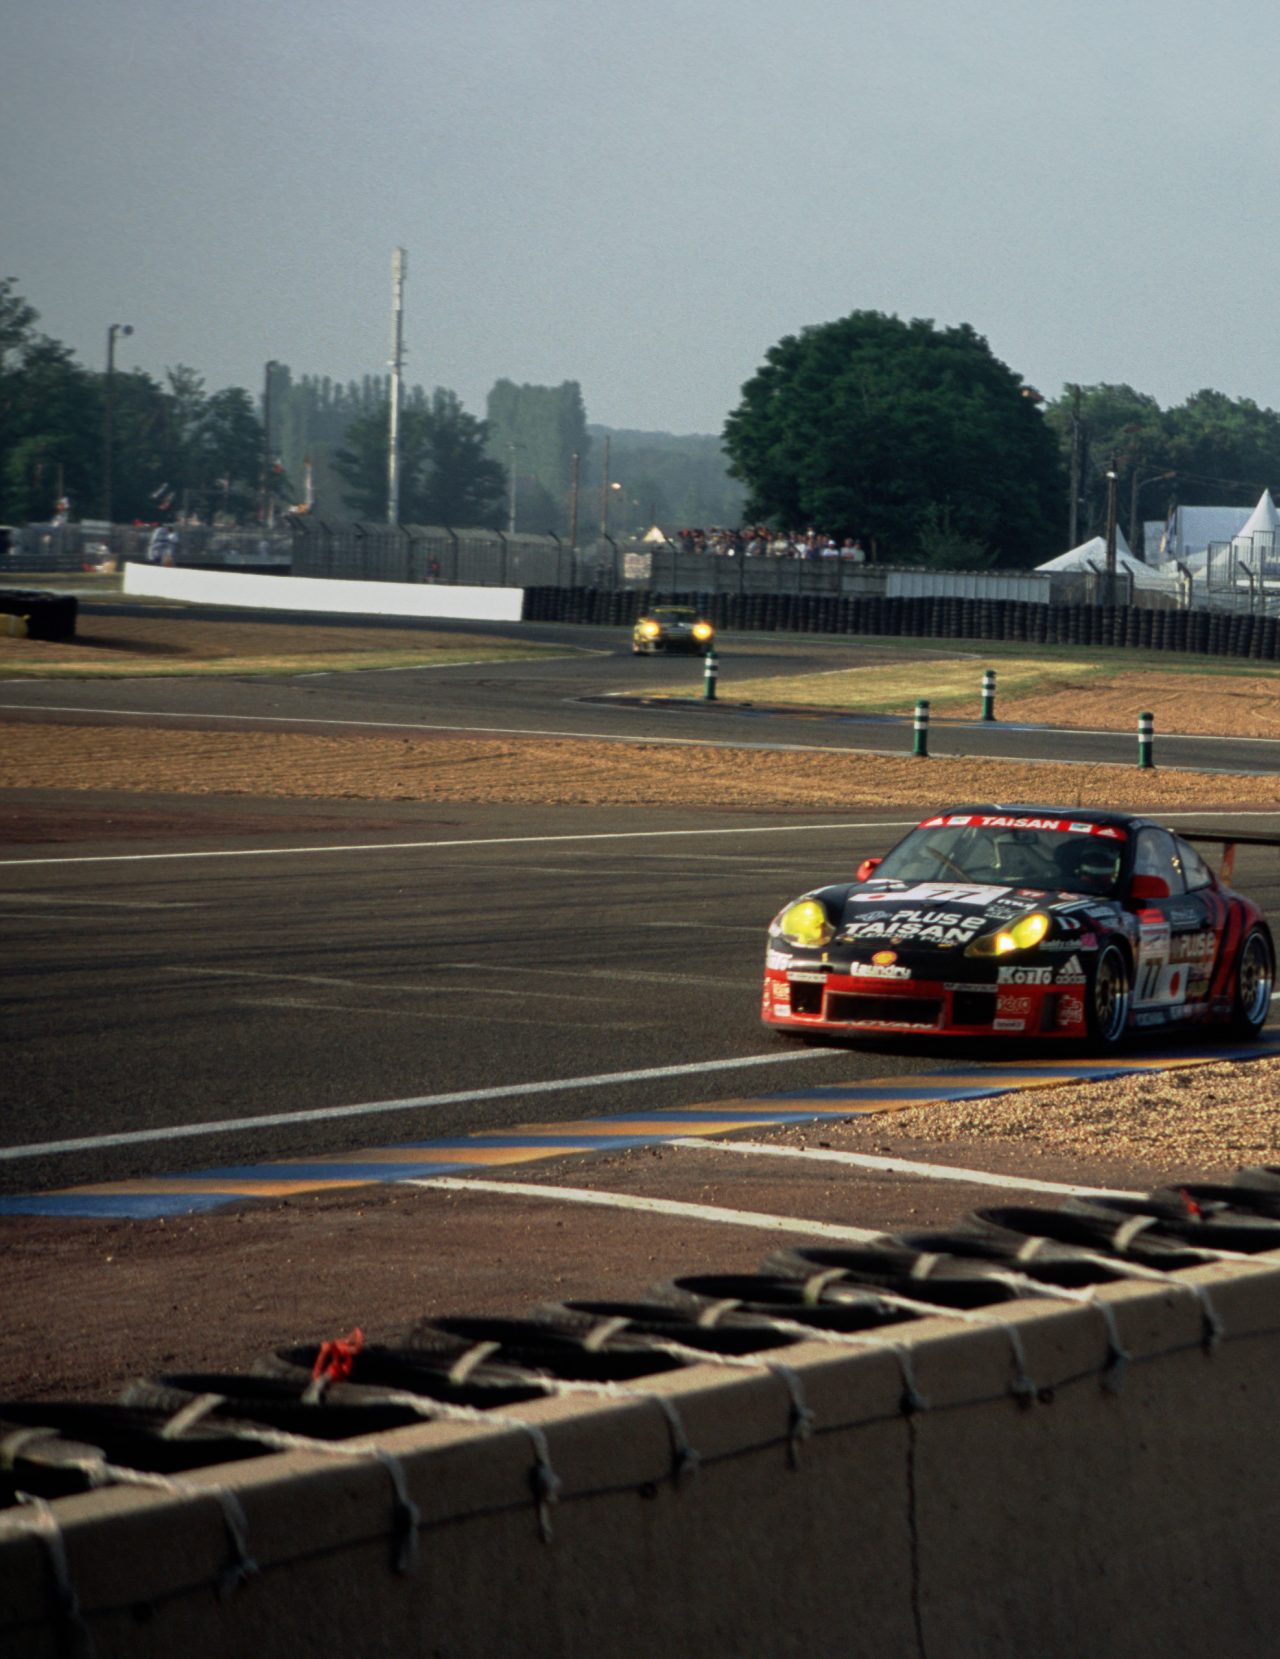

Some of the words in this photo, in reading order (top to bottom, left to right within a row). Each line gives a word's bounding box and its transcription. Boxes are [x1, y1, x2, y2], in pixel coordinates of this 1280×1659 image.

[981, 816, 1060, 830] TAISAN
[926, 889, 980, 901] 77
[844, 923, 976, 943] TAISAN
[1141, 957, 1163, 1000] 77
